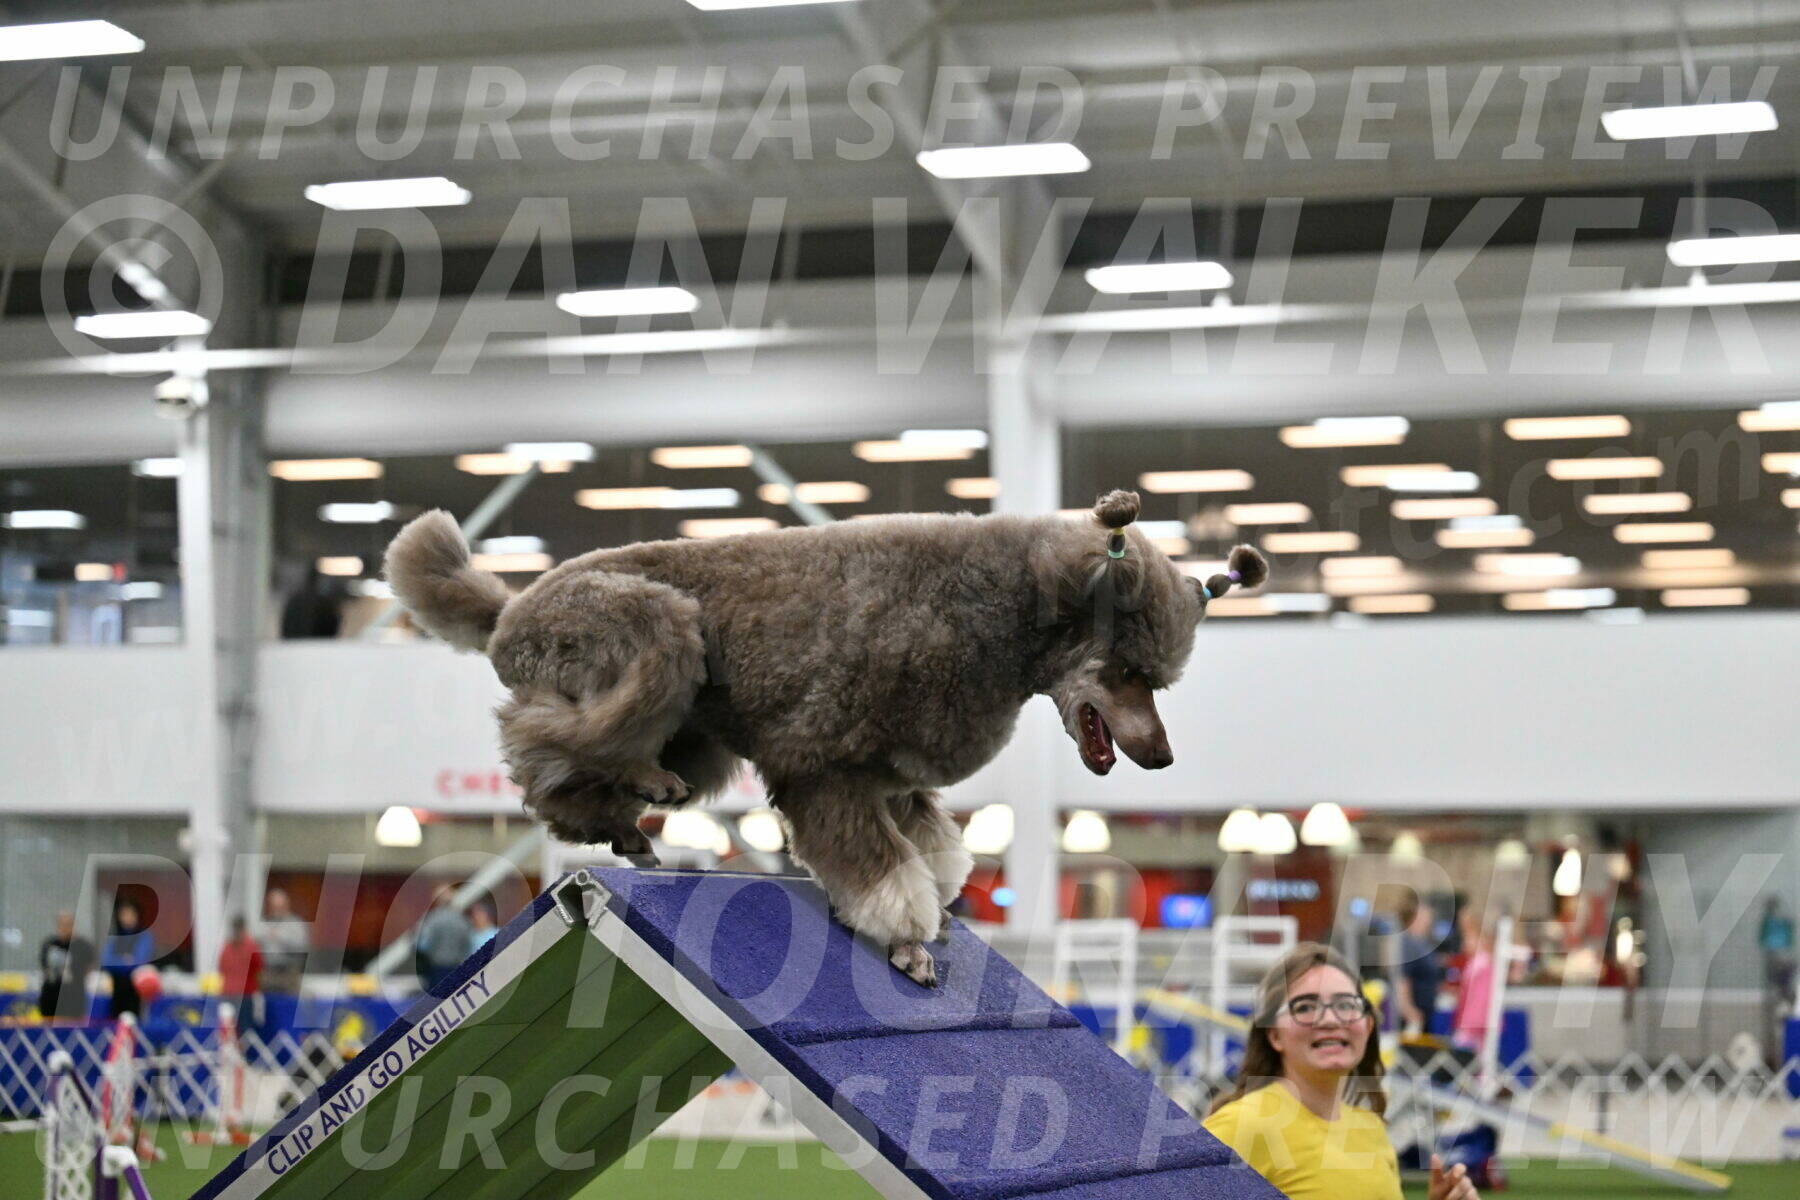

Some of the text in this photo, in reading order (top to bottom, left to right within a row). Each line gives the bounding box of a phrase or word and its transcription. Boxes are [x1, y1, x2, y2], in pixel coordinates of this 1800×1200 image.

[267, 971, 491, 1175] CLIP AND GO AGILITY
